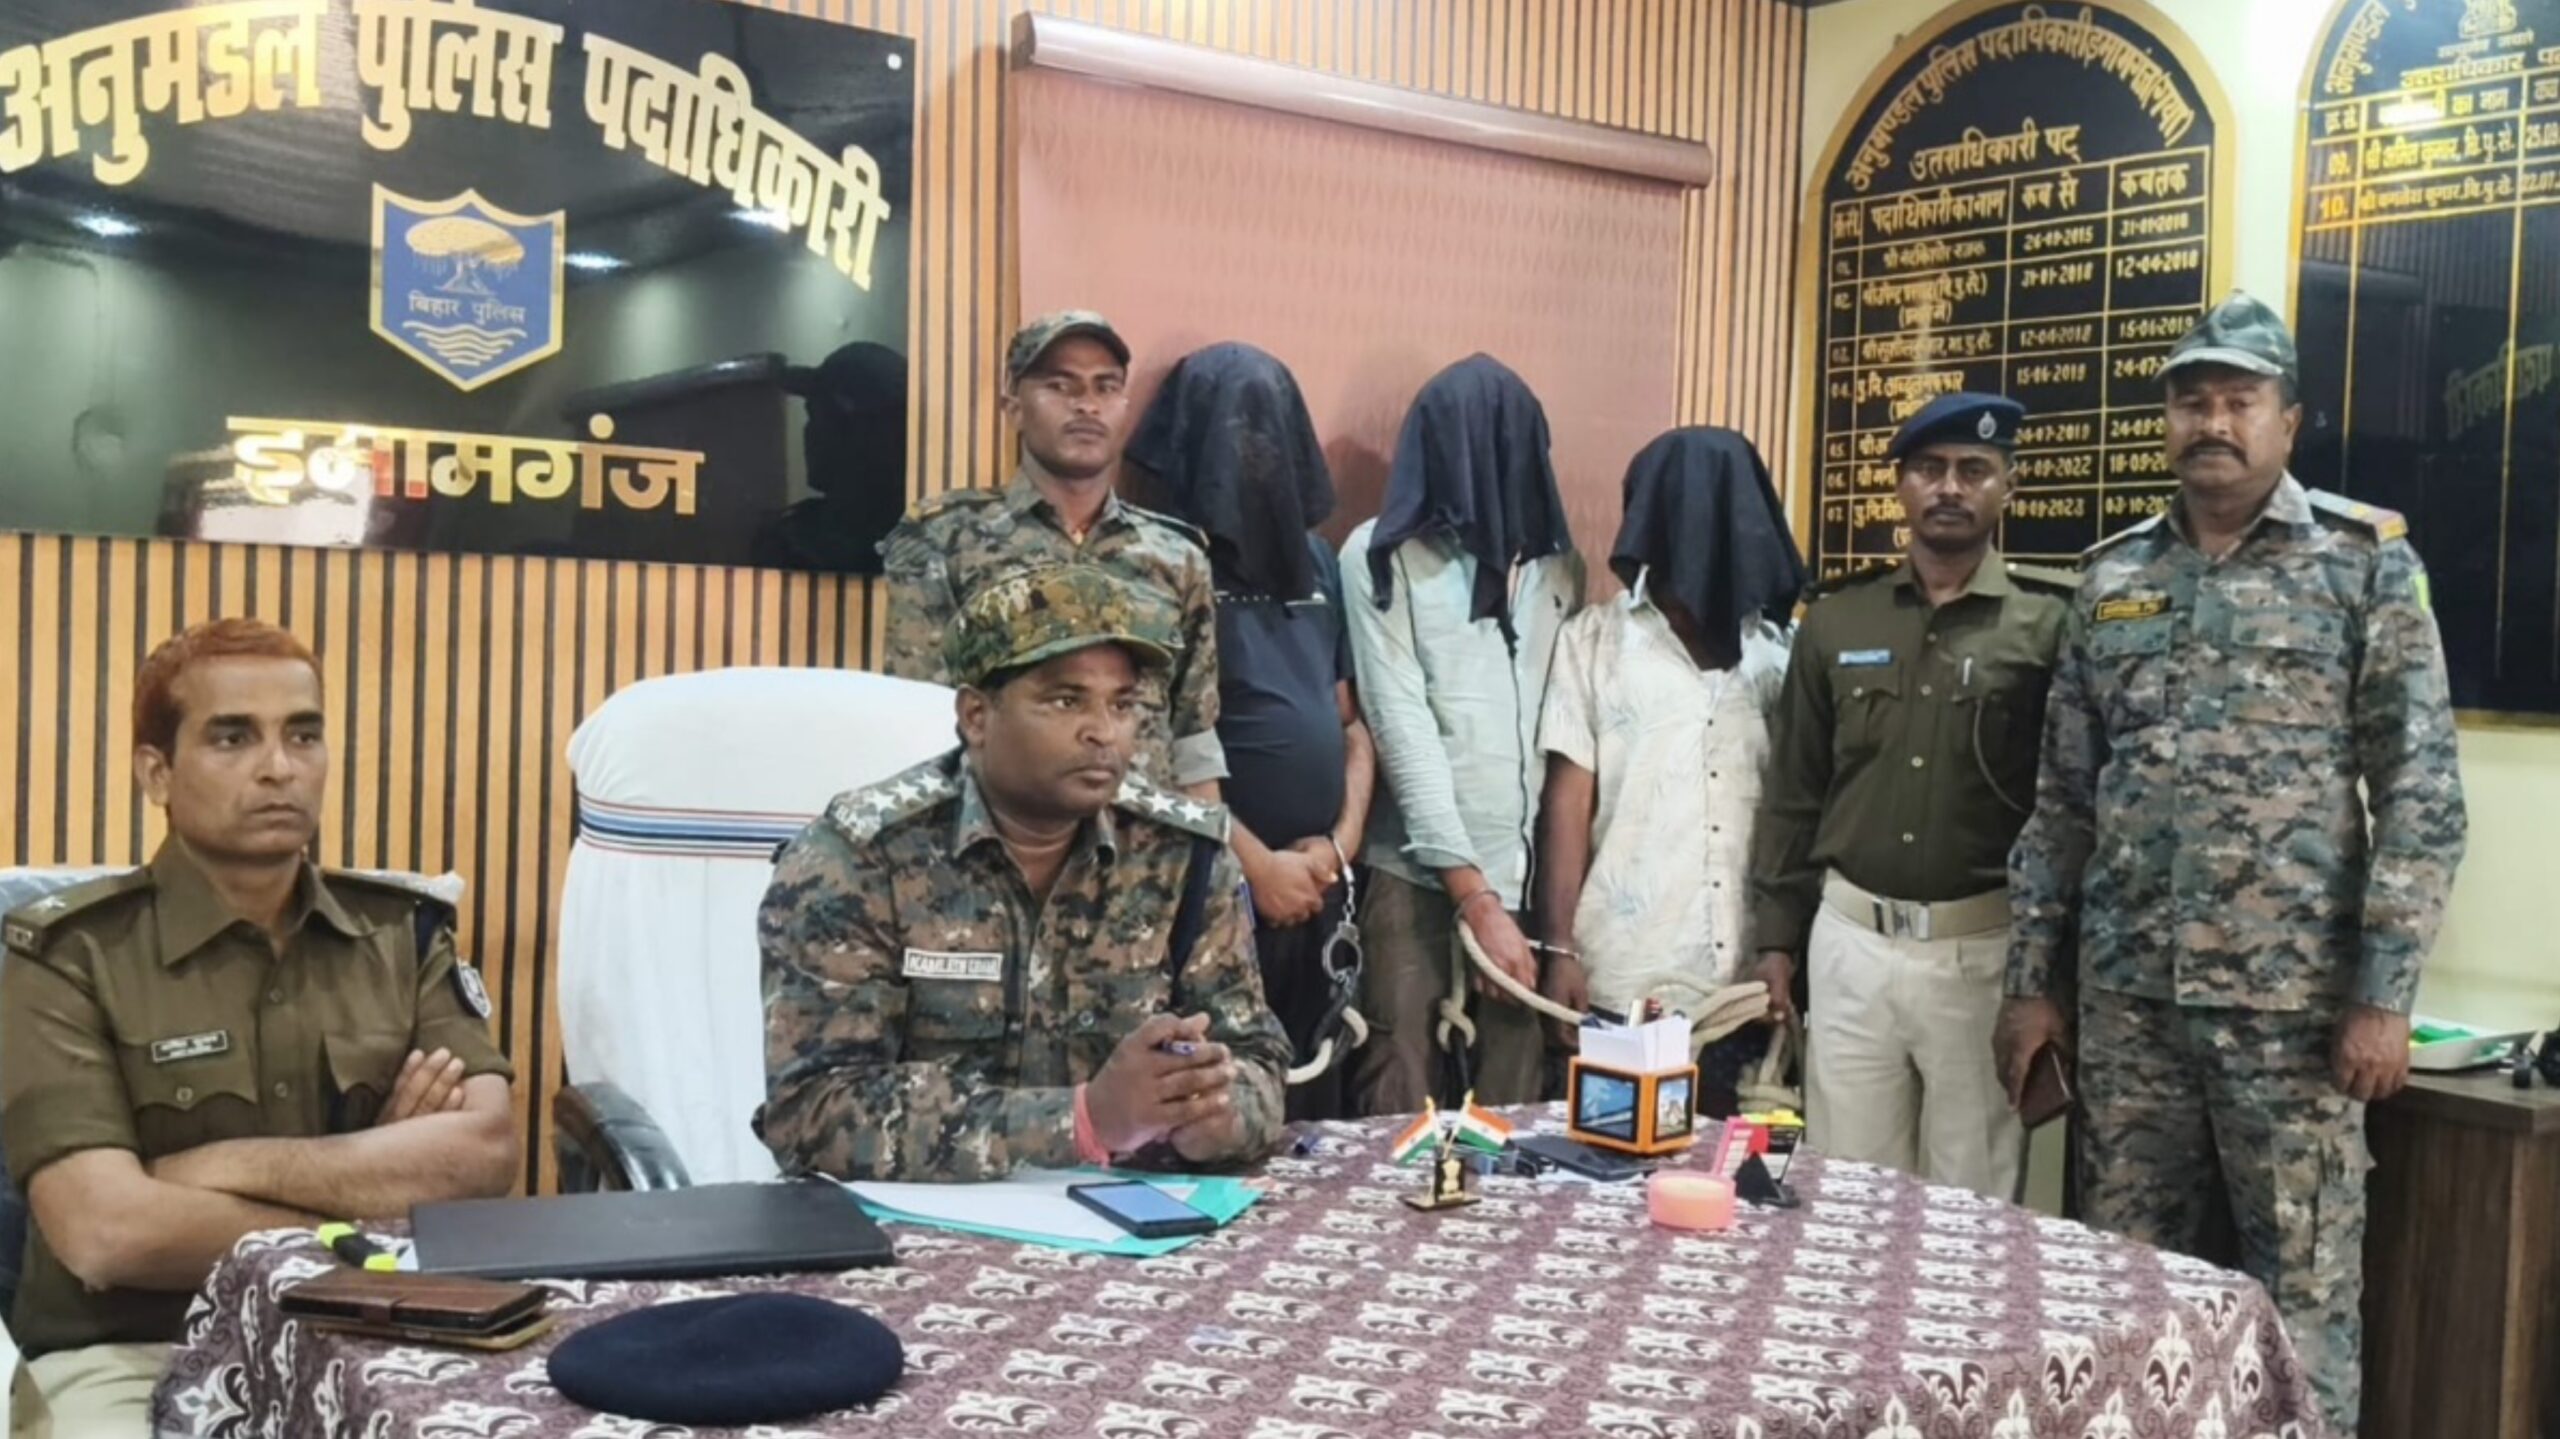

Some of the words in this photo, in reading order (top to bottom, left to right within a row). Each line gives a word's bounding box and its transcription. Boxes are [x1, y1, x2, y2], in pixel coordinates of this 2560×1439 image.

[582, 31, 891, 291] पदाधिकारी
[227, 413, 705, 515] इमामगंज
[2110, 417, 2167, 438] 24-09-2
